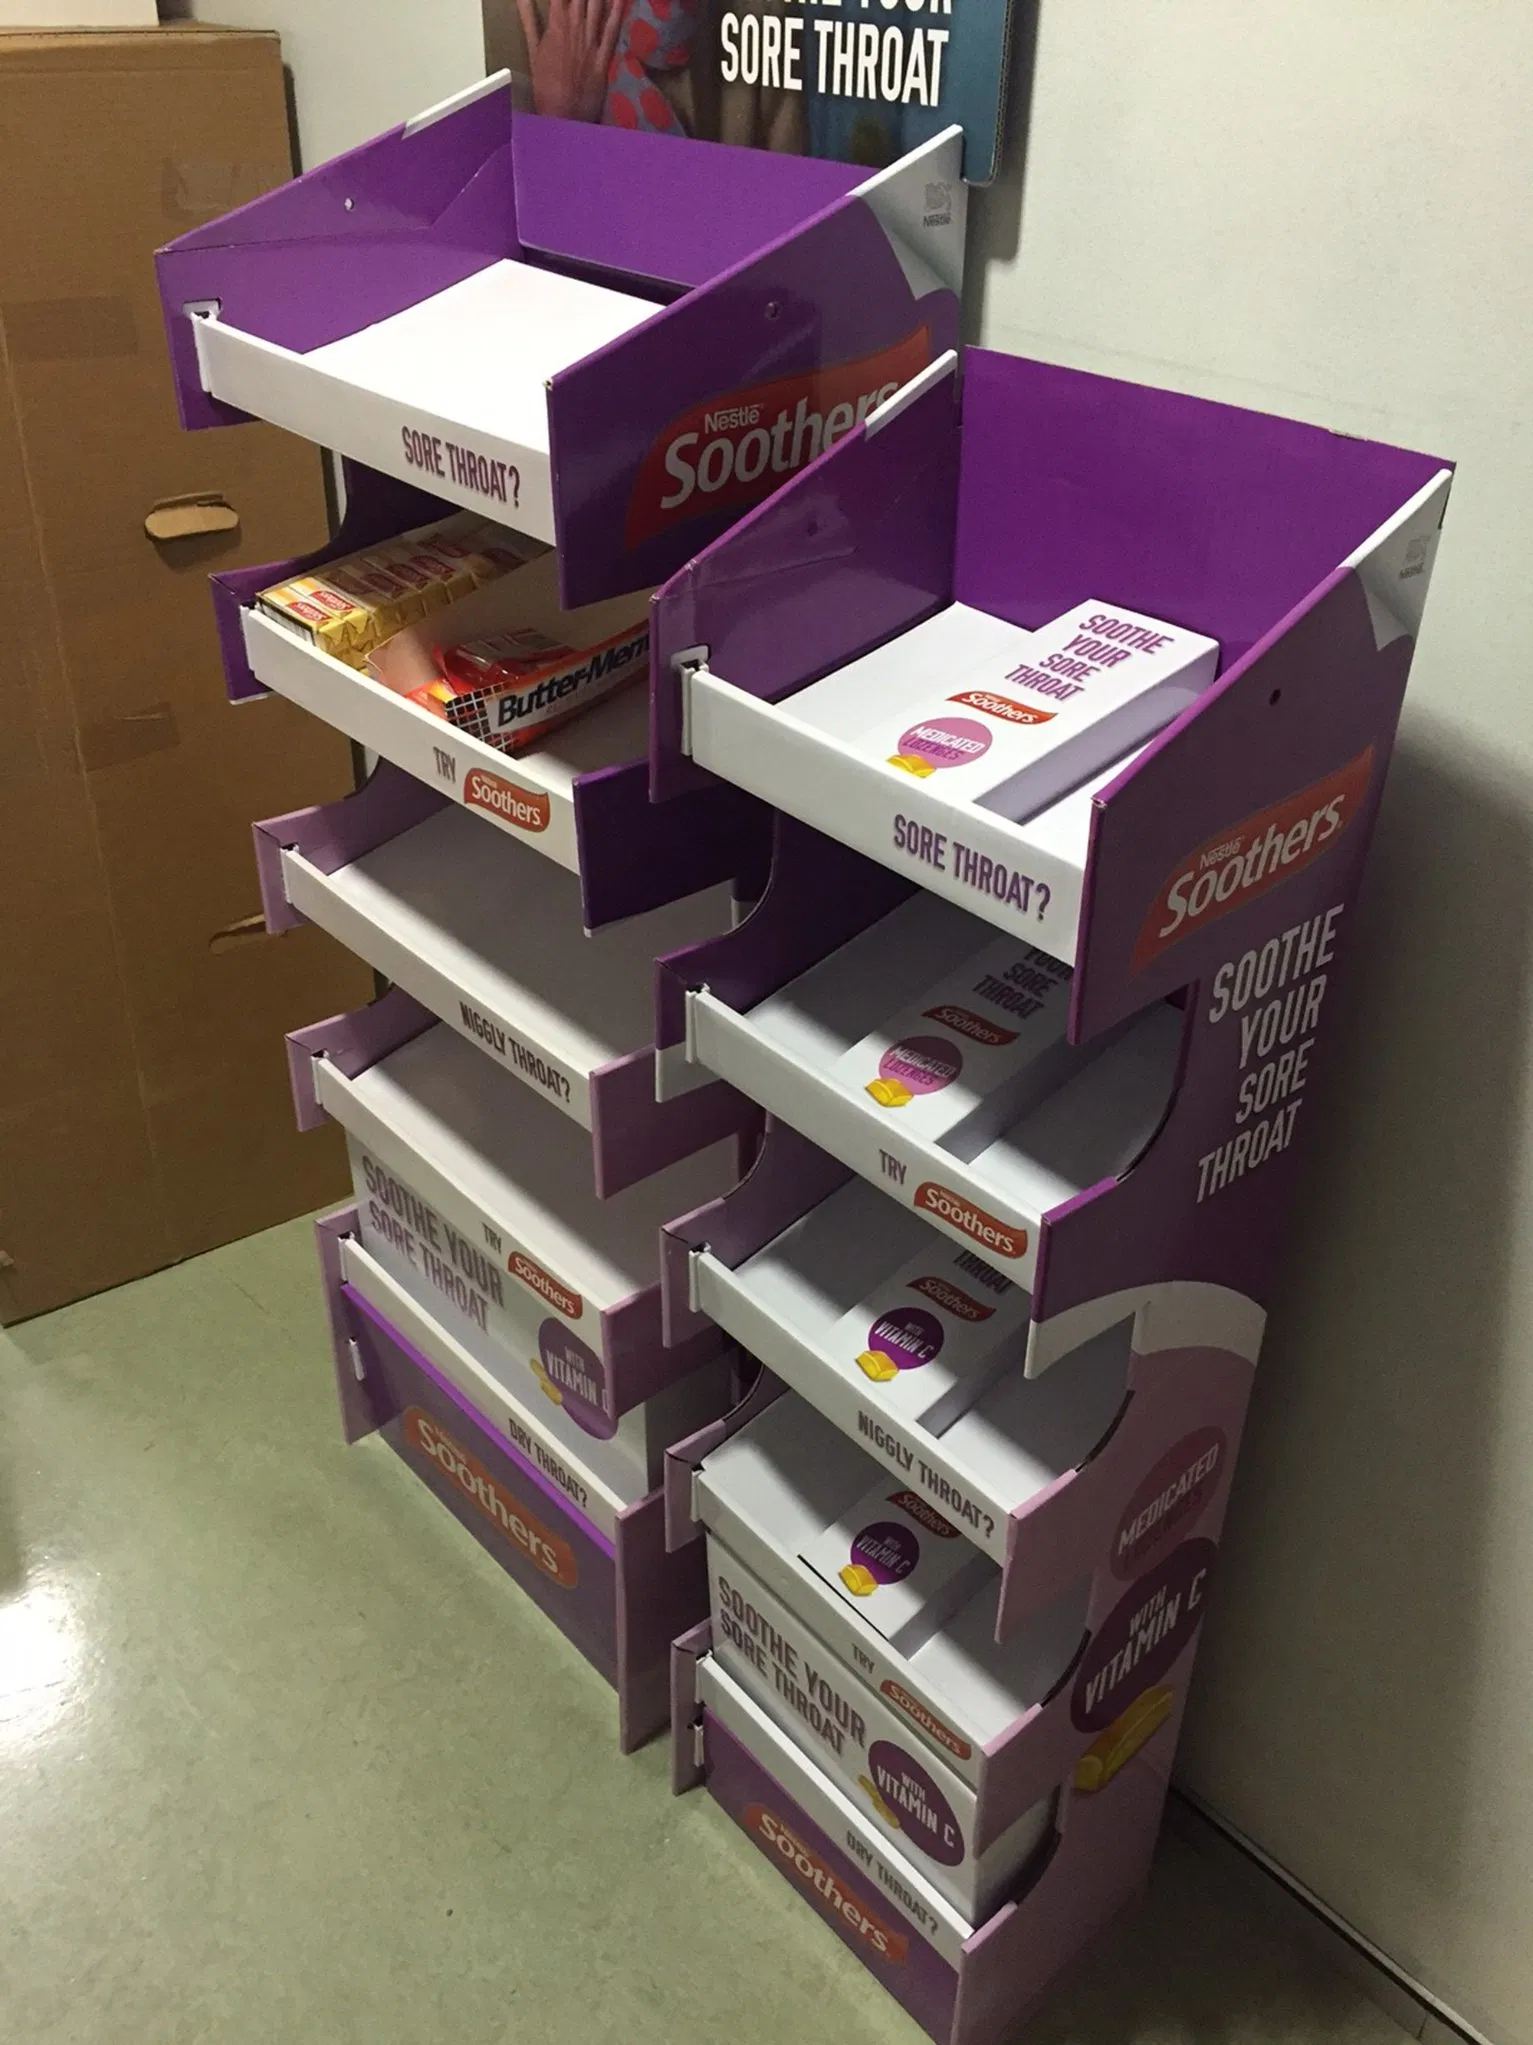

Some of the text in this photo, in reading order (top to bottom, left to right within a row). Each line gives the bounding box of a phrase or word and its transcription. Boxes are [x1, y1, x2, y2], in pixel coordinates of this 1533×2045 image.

[720, 12, 949, 108] SORE THROAT
[401, 425, 521, 508] SORE THROAT?
[1039, 653, 1101, 682] SORE
[1062, 633, 1132, 668] YOUR
[1078, 614, 1175, 655] SOOTHE
[961, 692, 1040, 723] Soothers
[1004, 663, 1085, 702] THROAT
[433, 746, 541, 826] TRY Soothers
[910, 726, 986, 753] MEDICATED
[893, 813, 1051, 922] SORE THROAT?
[1158, 794, 1345, 939] Soothers
[971, 974, 1045, 1021] THROAT
[1003, 962, 1059, 998] SORE
[1209, 903, 1345, 1024] SOOTHE
[459, 1001, 570, 1103] NIGGLY THROAT?
[934, 1008, 1002, 1043] Soothers
[1239, 974, 1328, 1070] YOUR
[1235, 1037, 1315, 1124] SORE
[1196, 1098, 1303, 1204] THROAT
[362, 1155, 504, 1308] SOOTHE YOUR
[879, 1148, 1015, 1252] TRY Soothers
[369, 1199, 488, 1336] SORE THROAT
[482, 1222, 575, 1315] TRY Soothers
[546, 1350, 598, 1405] VITAMIN
[874, 1320, 935, 1359] VITAMIN C
[417, 1418, 559, 1574] Soothers
[508, 1418, 533, 1454] DRY
[534, 1442, 588, 1509] THROAT?
[858, 1410, 995, 1539] NIGGLY THROAT?
[1117, 1442, 1220, 1556] MEDICATED
[856, 1534, 912, 1574] VITAMIN C
[1084, 1567, 1208, 1715] VITAMIN C
[1128, 1584, 1168, 1638] WITH
[718, 1576, 866, 1749] SOOTHE YOUR
[720, 1608, 767, 1678] SORE
[771, 1662, 845, 1756] THROAT
[852, 1643, 961, 1756] TRY Soothers
[876, 1764, 955, 1848] VITAMIN C
[901, 1772, 927, 1800] WITH
[758, 1813, 889, 1952] Soothers
[846, 1829, 939, 1936] DRY THROAT?
